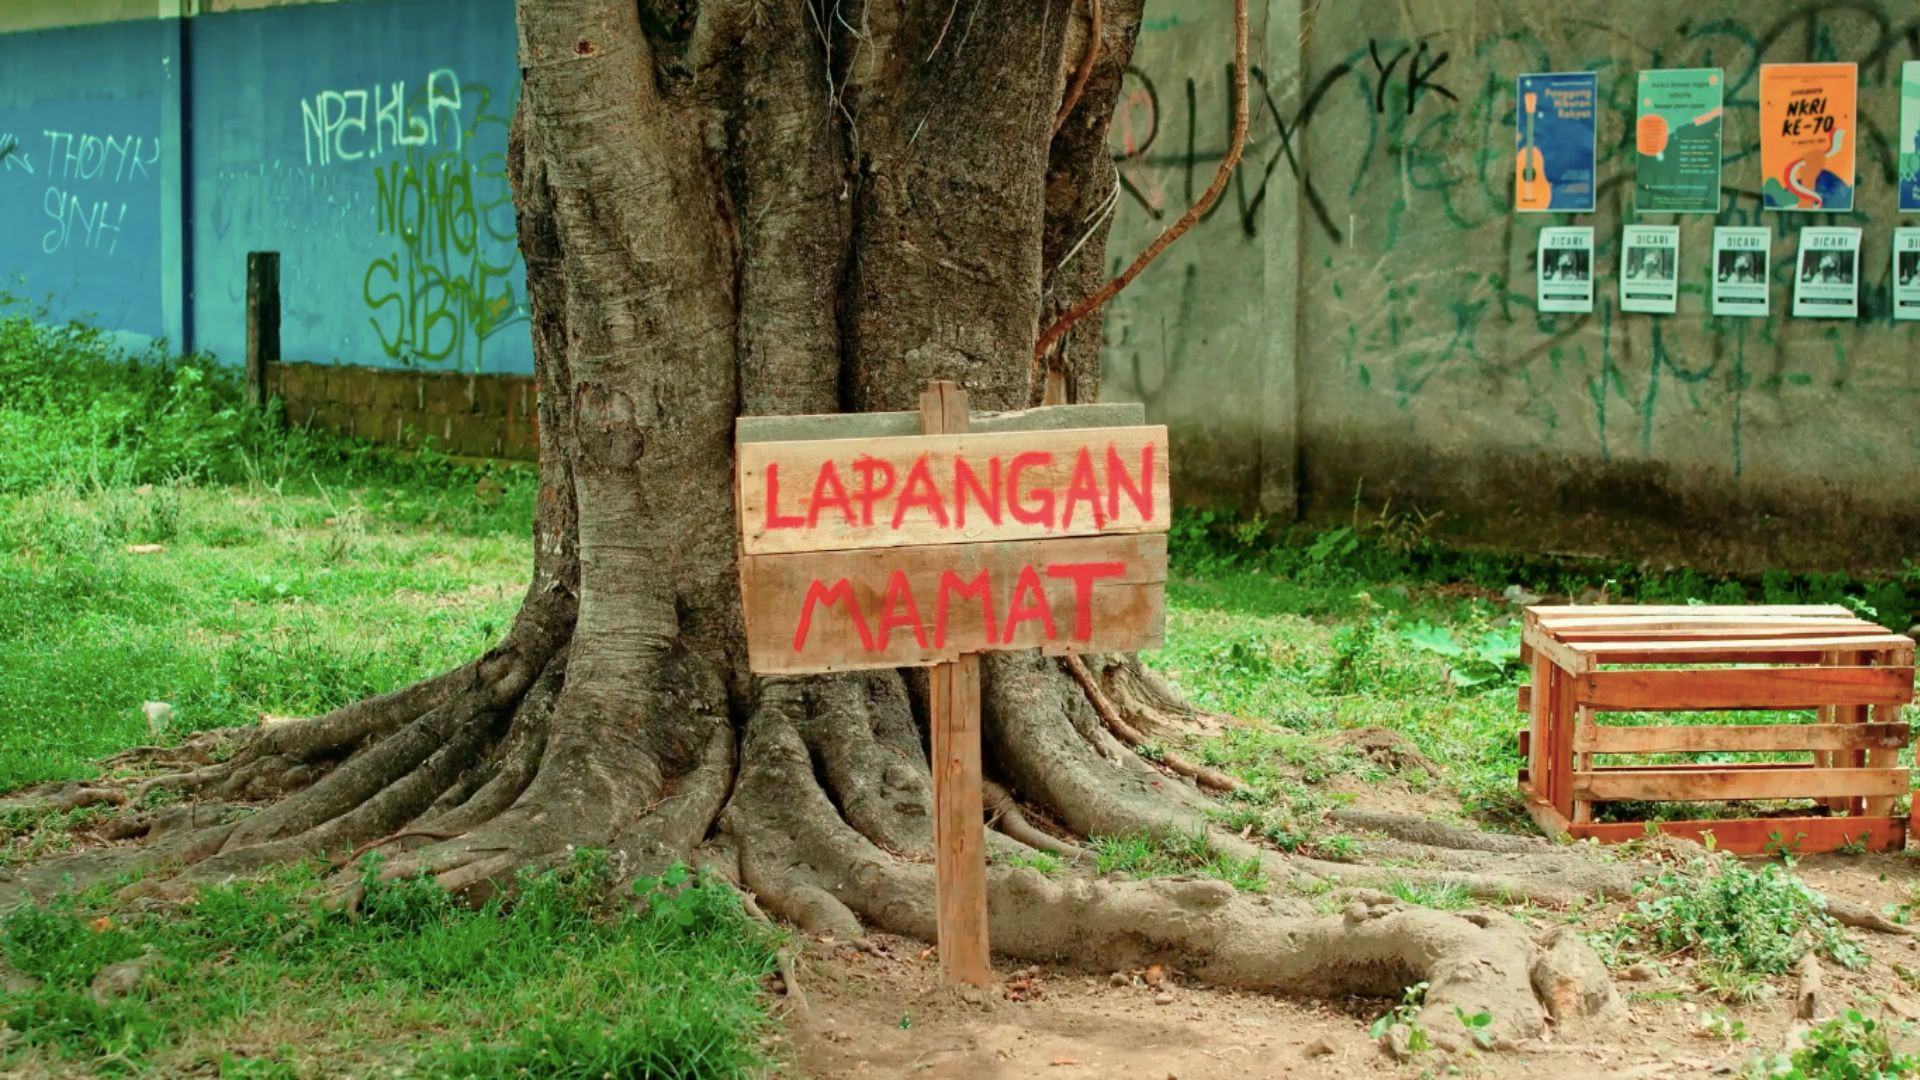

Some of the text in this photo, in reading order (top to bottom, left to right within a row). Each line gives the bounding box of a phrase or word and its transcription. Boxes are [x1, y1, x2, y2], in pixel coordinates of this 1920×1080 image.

[1782, 116, 1834, 137] KE-70
[1786, 98, 1827, 118] NKRI
[765, 442, 1155, 530] LAPANGAN
[793, 561, 1127, 652] MAMAT
